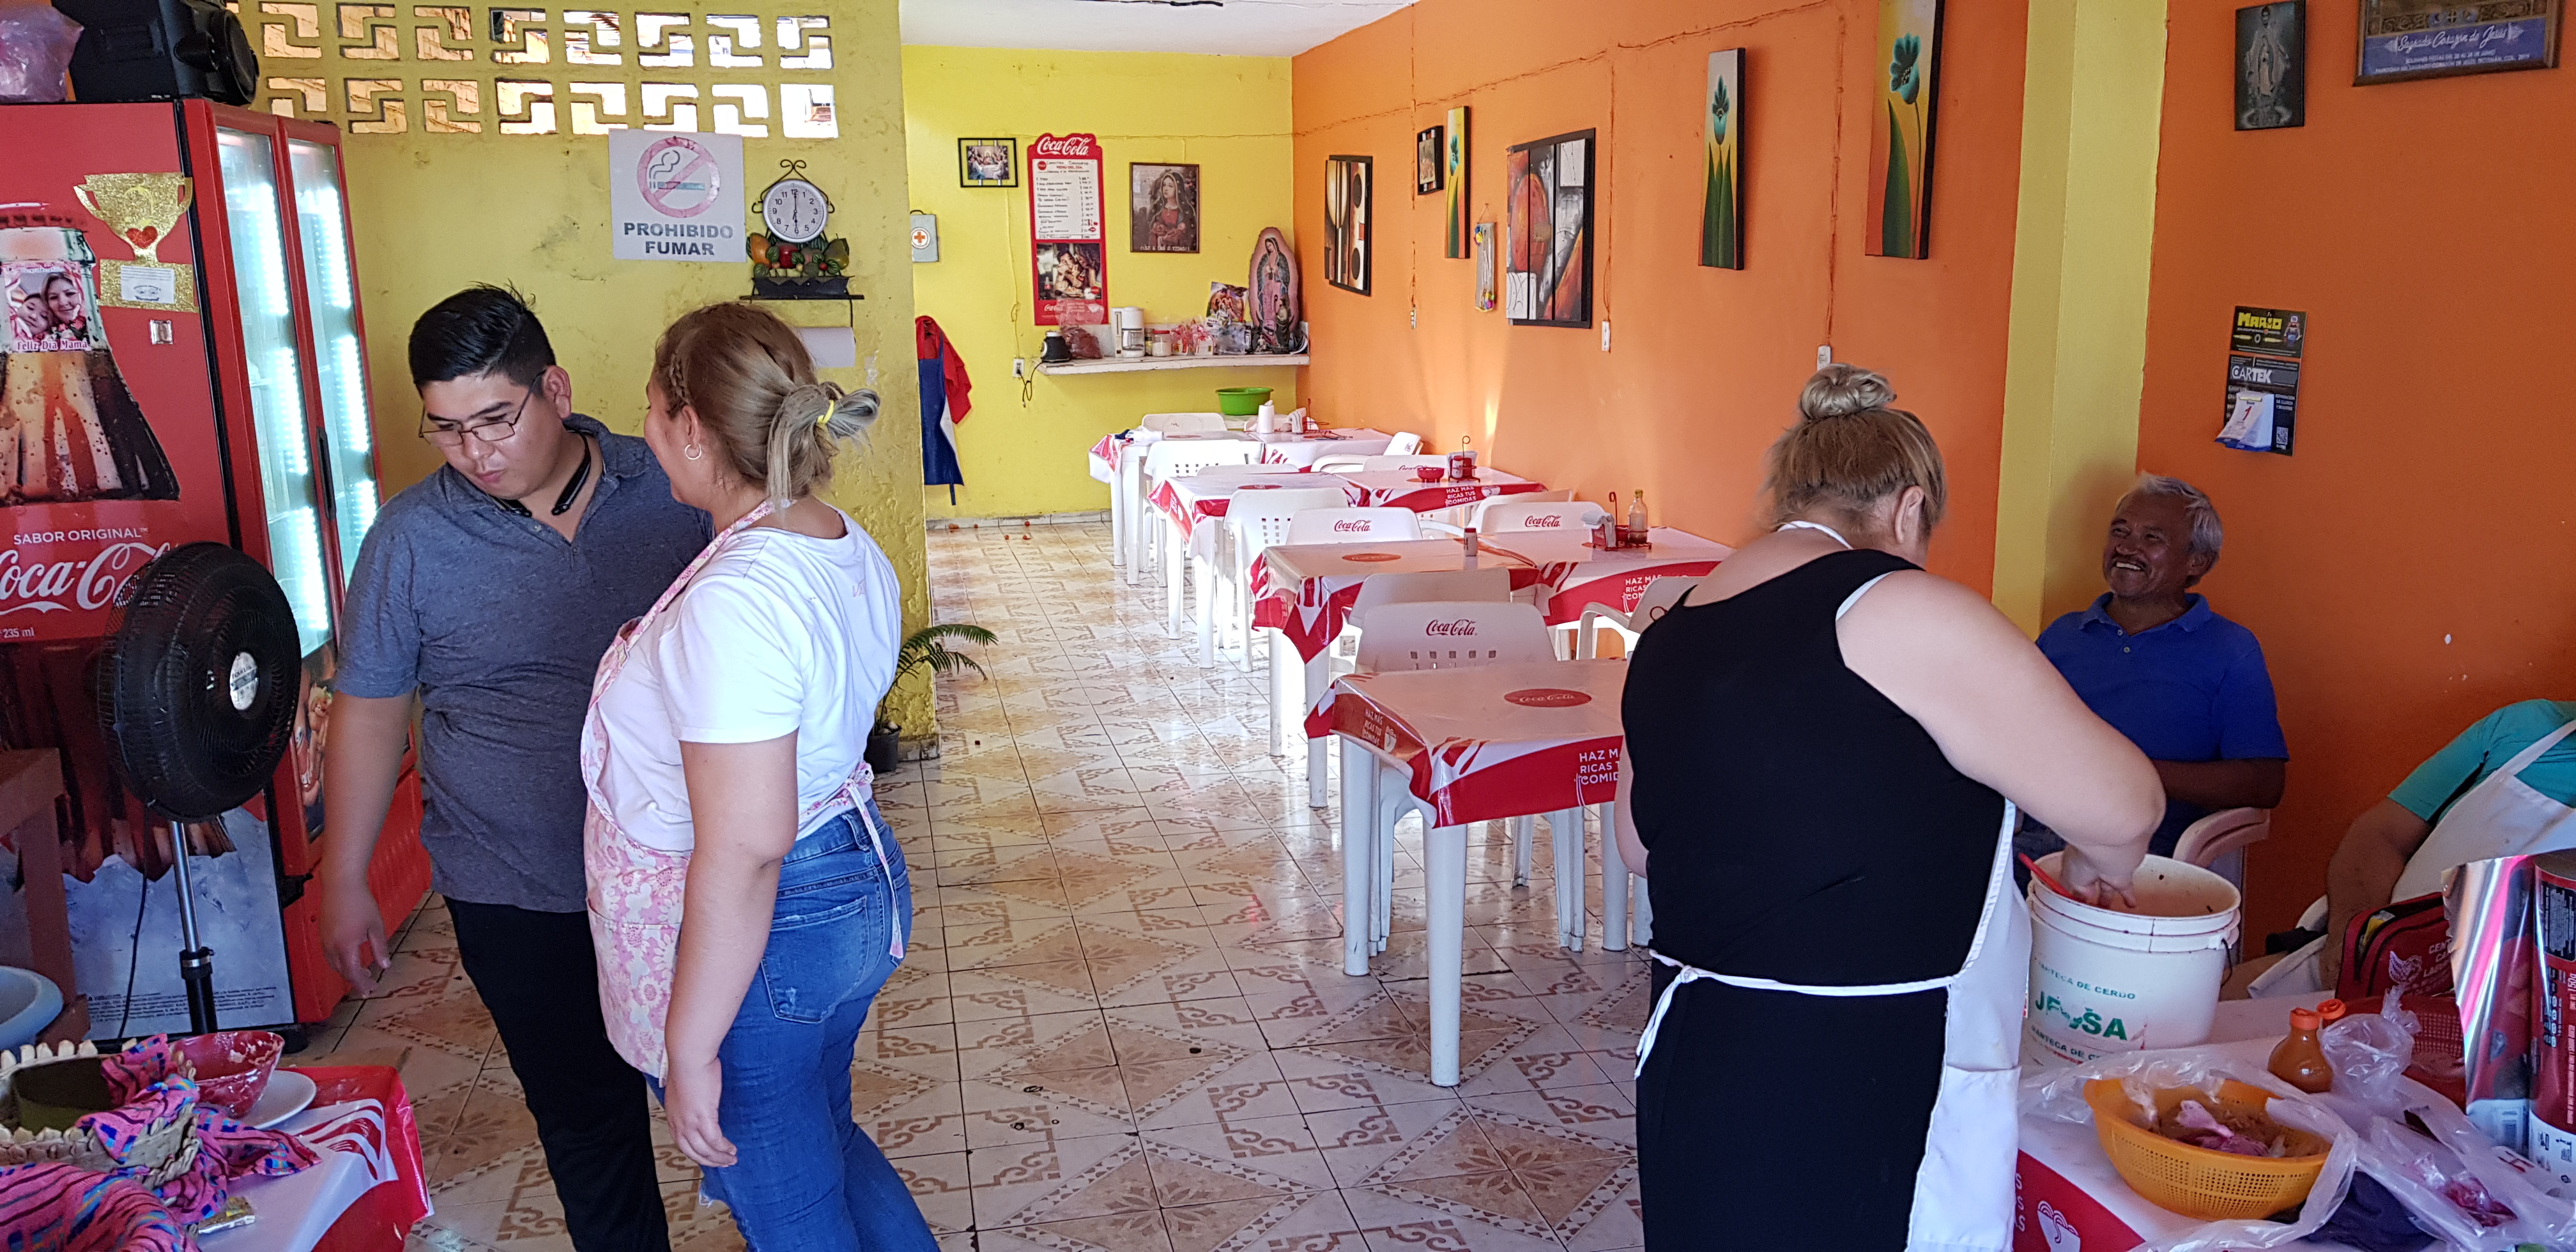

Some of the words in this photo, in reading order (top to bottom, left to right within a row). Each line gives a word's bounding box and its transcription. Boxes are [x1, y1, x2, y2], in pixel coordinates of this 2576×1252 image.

[1037, 136, 1092, 155] Coca-Cola
[624, 222, 733, 239] PROHIBIDO
[645, 241, 715, 256] FUMAR
[2232, 365, 2273, 383] CARTEK
[1334, 519, 1371, 532] Coca-Cola
[1524, 515, 1561, 527] Coca-Cola
[13, 531, 65, 545] SABOR
[1625, 577, 1643, 586] HAZ
[1426, 619, 1476, 636] Coca-Cola
[1579, 750, 1605, 763] HAZ
[1580, 762, 1613, 774] RICAS
[1580, 773, 1619, 785] COMID
[2077, 981, 2091, 991] DE
[2095, 986, 2136, 1000] CERDO
